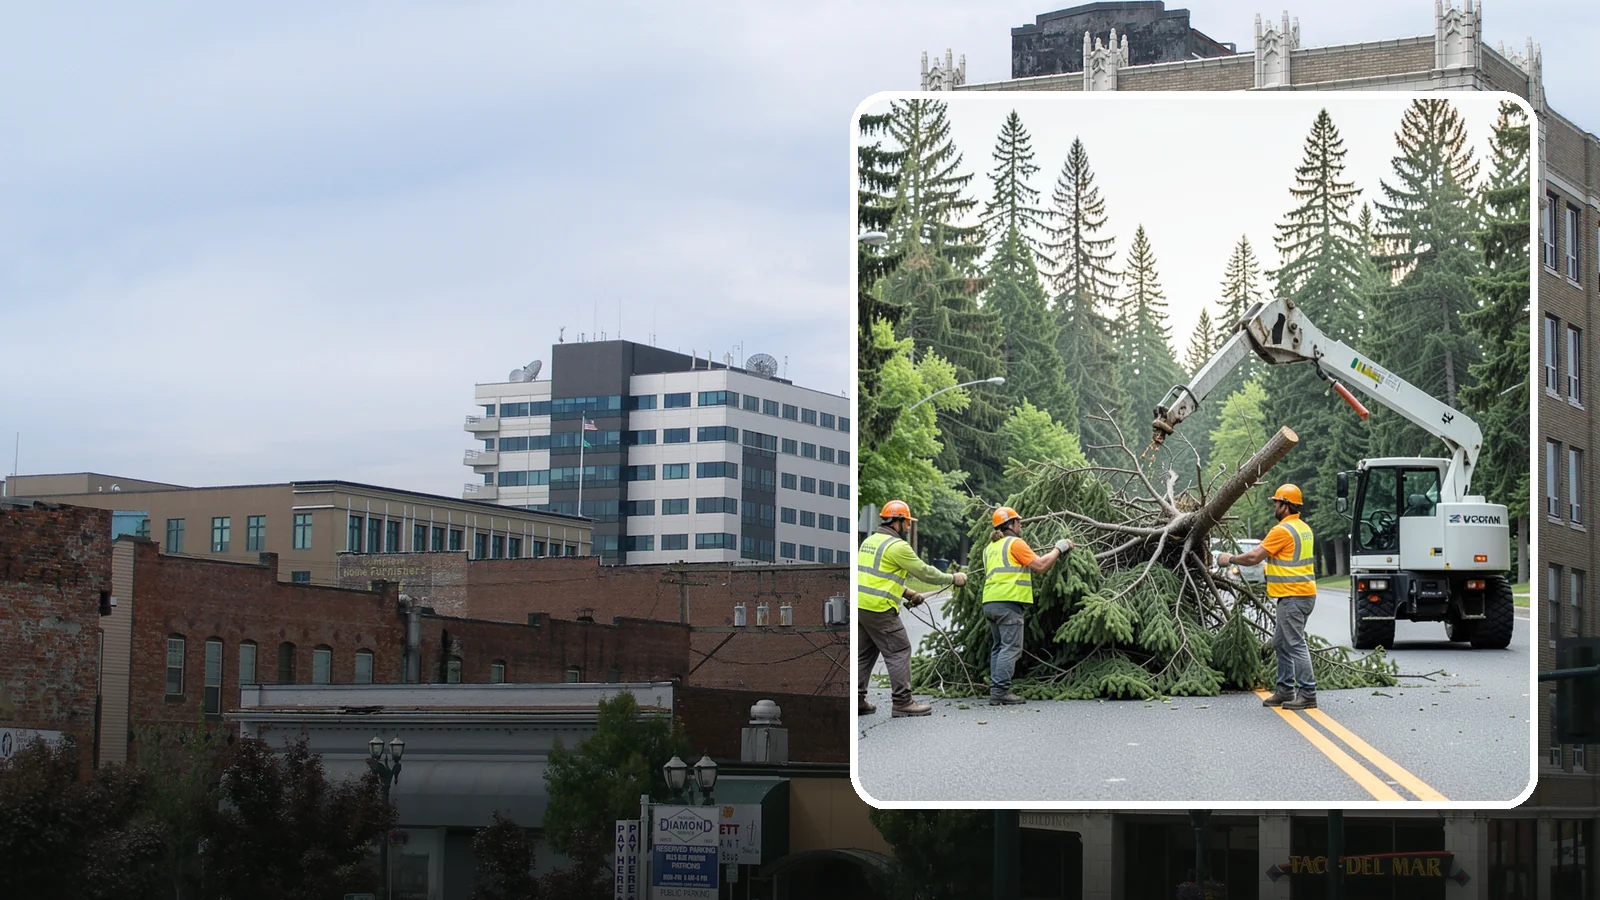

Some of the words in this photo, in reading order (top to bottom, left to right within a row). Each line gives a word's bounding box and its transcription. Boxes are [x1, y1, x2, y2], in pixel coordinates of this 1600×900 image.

[344, 568, 368, 577] Home
[370, 566, 426, 576] Furnishers
[660, 818, 712, 832] DIAMOND
[1022, 815, 1070, 828] BUILDING
[656, 845, 688, 853] RESERVED
[722, 852, 738, 862] Soup
[1345, 856, 1385, 875] DEL
[1392, 856, 1442, 877] MAR
[660, 889, 681, 897] PUBLIC
[684, 889, 710, 898] PARKING
